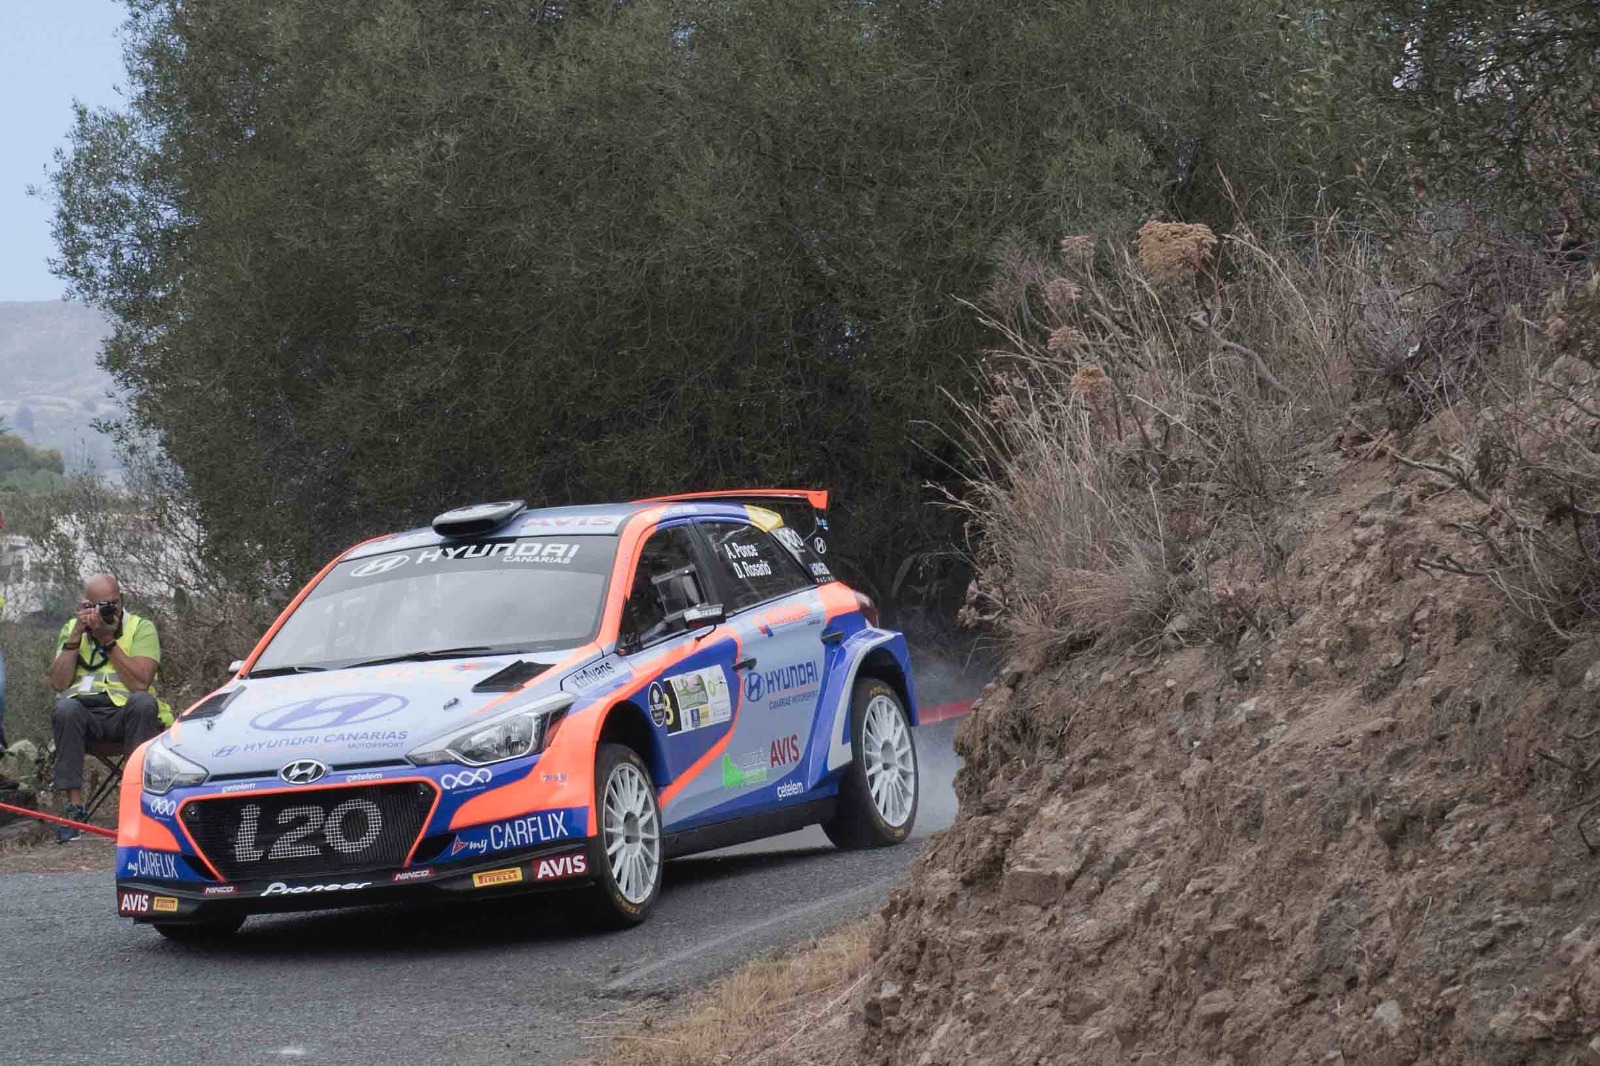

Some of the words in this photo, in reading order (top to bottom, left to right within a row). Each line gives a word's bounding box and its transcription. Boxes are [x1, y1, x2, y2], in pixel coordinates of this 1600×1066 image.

[416, 542, 580, 565] HYUNDAI
[502, 555, 572, 565] CANARIAS
[723, 543, 737, 560] A.
[731, 542, 759, 558] Ponce
[732, 561, 746, 579] D.
[764, 660, 819, 695] HYUNDAI
[244, 735, 319, 751] HYUNDAI
[323, 730, 409, 743] CANARIAS
[770, 734, 799, 768] AVIS
[469, 839, 488, 854] my
[489, 811, 569, 850] CARFLIX
[127, 861, 138, 877] my
[138, 850, 179, 878] CARFLIX
[537, 855, 587, 879] AVIS
[394, 869, 430, 881] NINCO
[477, 868, 519, 885] PIRELLI
[260, 882, 372, 897] Pioneer
[121, 893, 149, 912] AVIS
